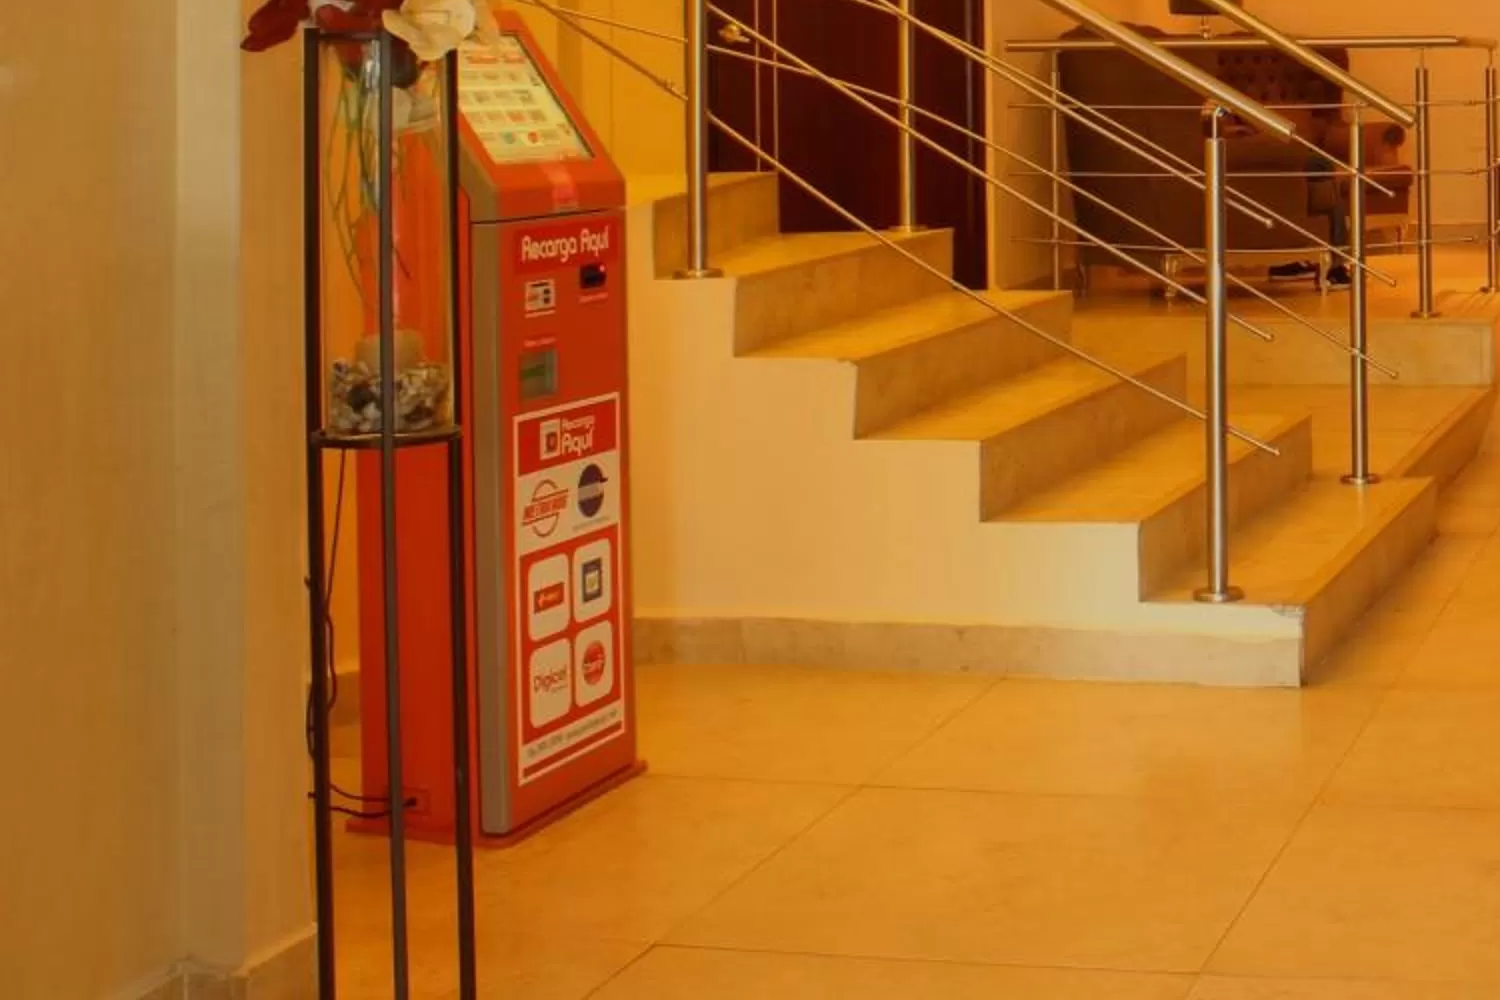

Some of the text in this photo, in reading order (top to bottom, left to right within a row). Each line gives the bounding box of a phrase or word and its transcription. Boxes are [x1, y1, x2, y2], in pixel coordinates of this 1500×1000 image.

[521, 225, 609, 263] Recarga Aquí
[562, 428, 594, 457] Aquí
